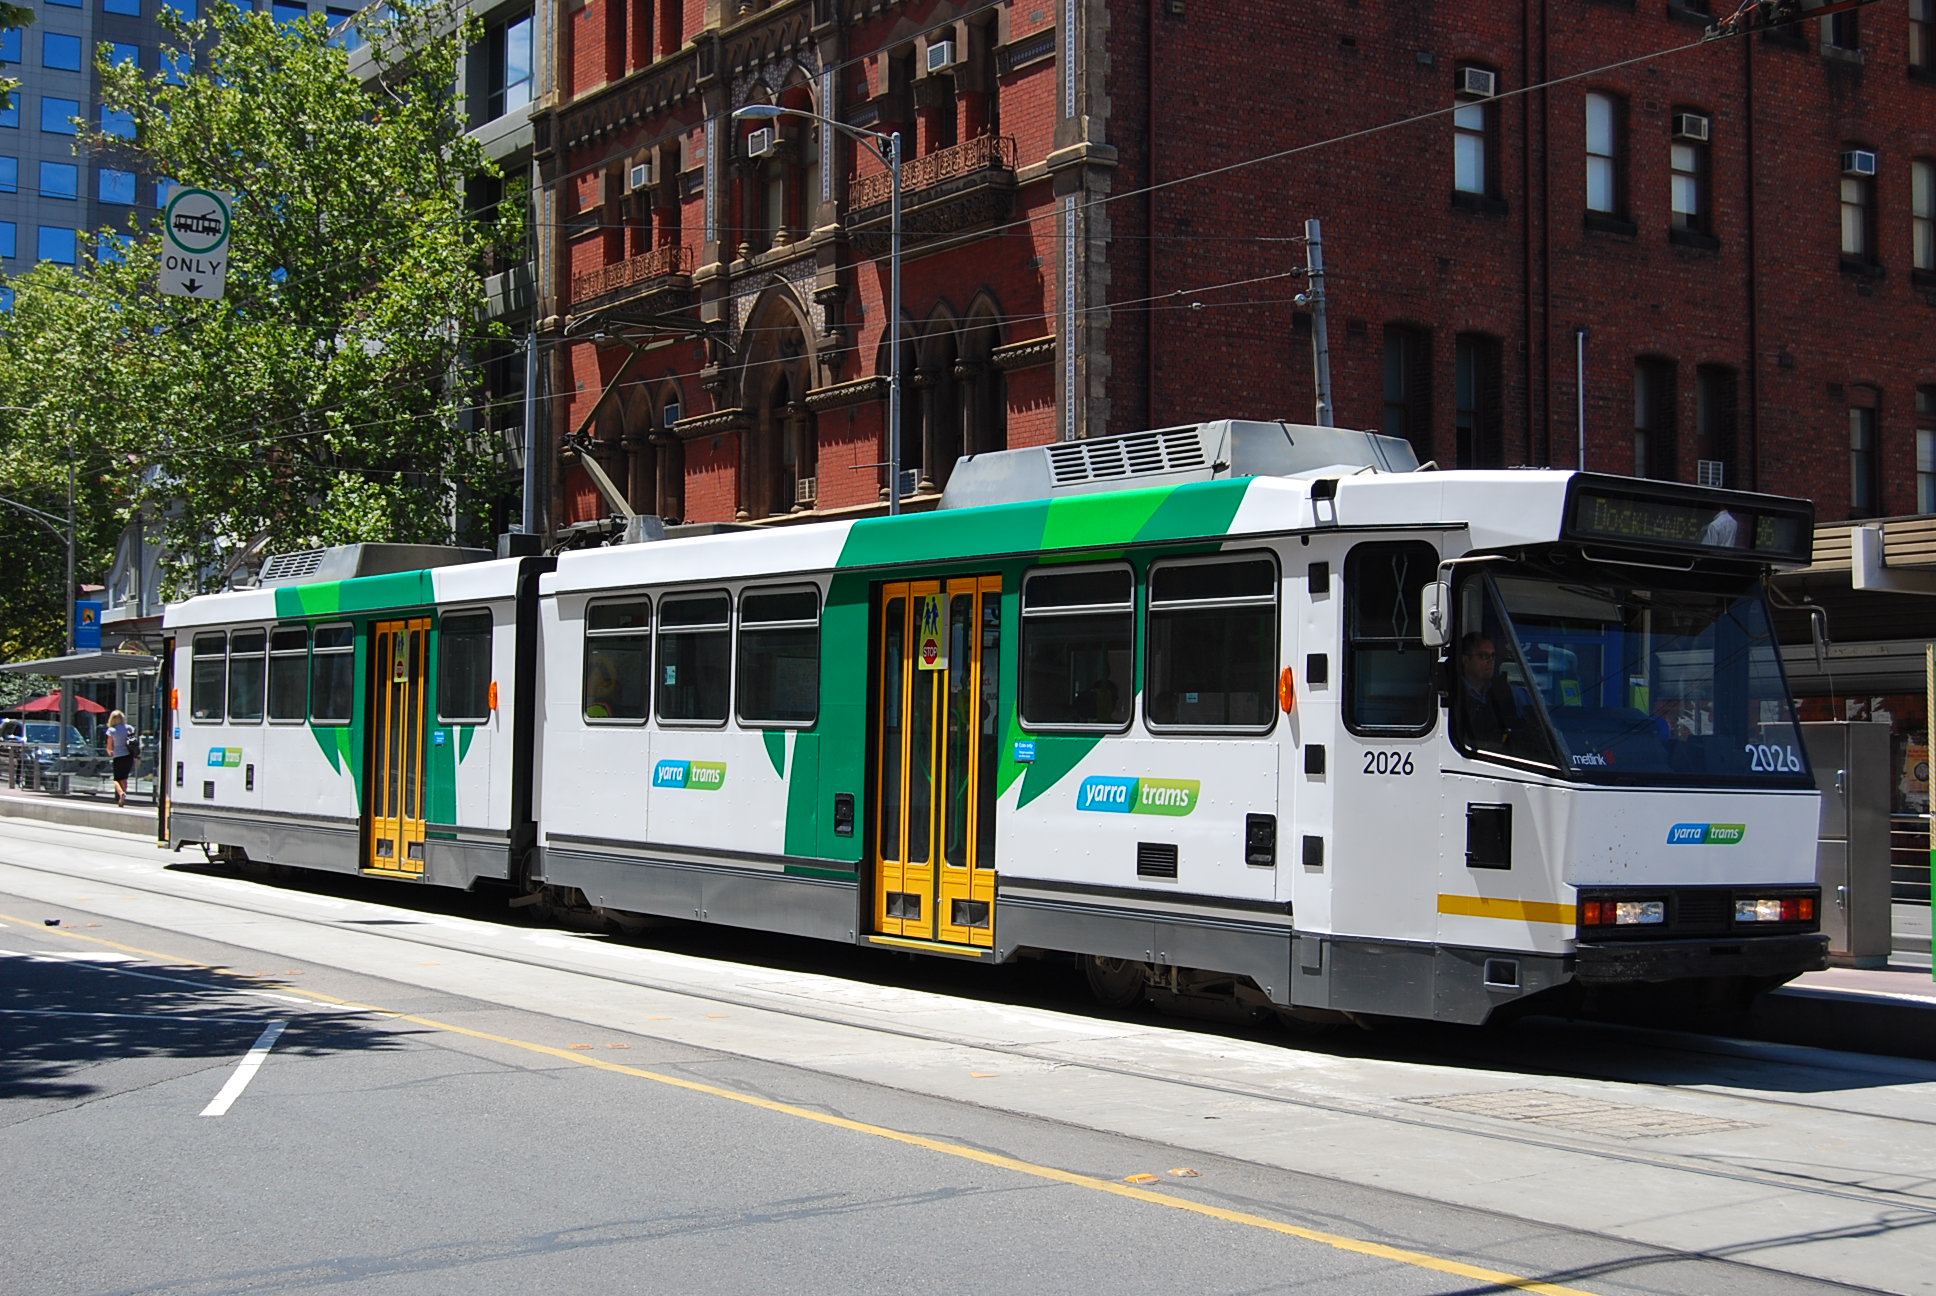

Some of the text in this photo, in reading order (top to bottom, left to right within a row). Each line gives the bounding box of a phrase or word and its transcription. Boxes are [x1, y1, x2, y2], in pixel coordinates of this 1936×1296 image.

[166, 255, 222, 275] ONLY
[923, 646, 938, 658] STOP
[1363, 750, 1414, 776] 2026
[1572, 752, 1607, 766] metlink
[1744, 744, 1800, 772] 2026
[658, 765, 720, 784] yarra trams
[1085, 783, 1190, 807] yarra trams
[1673, 826, 1739, 842] yarra trams
